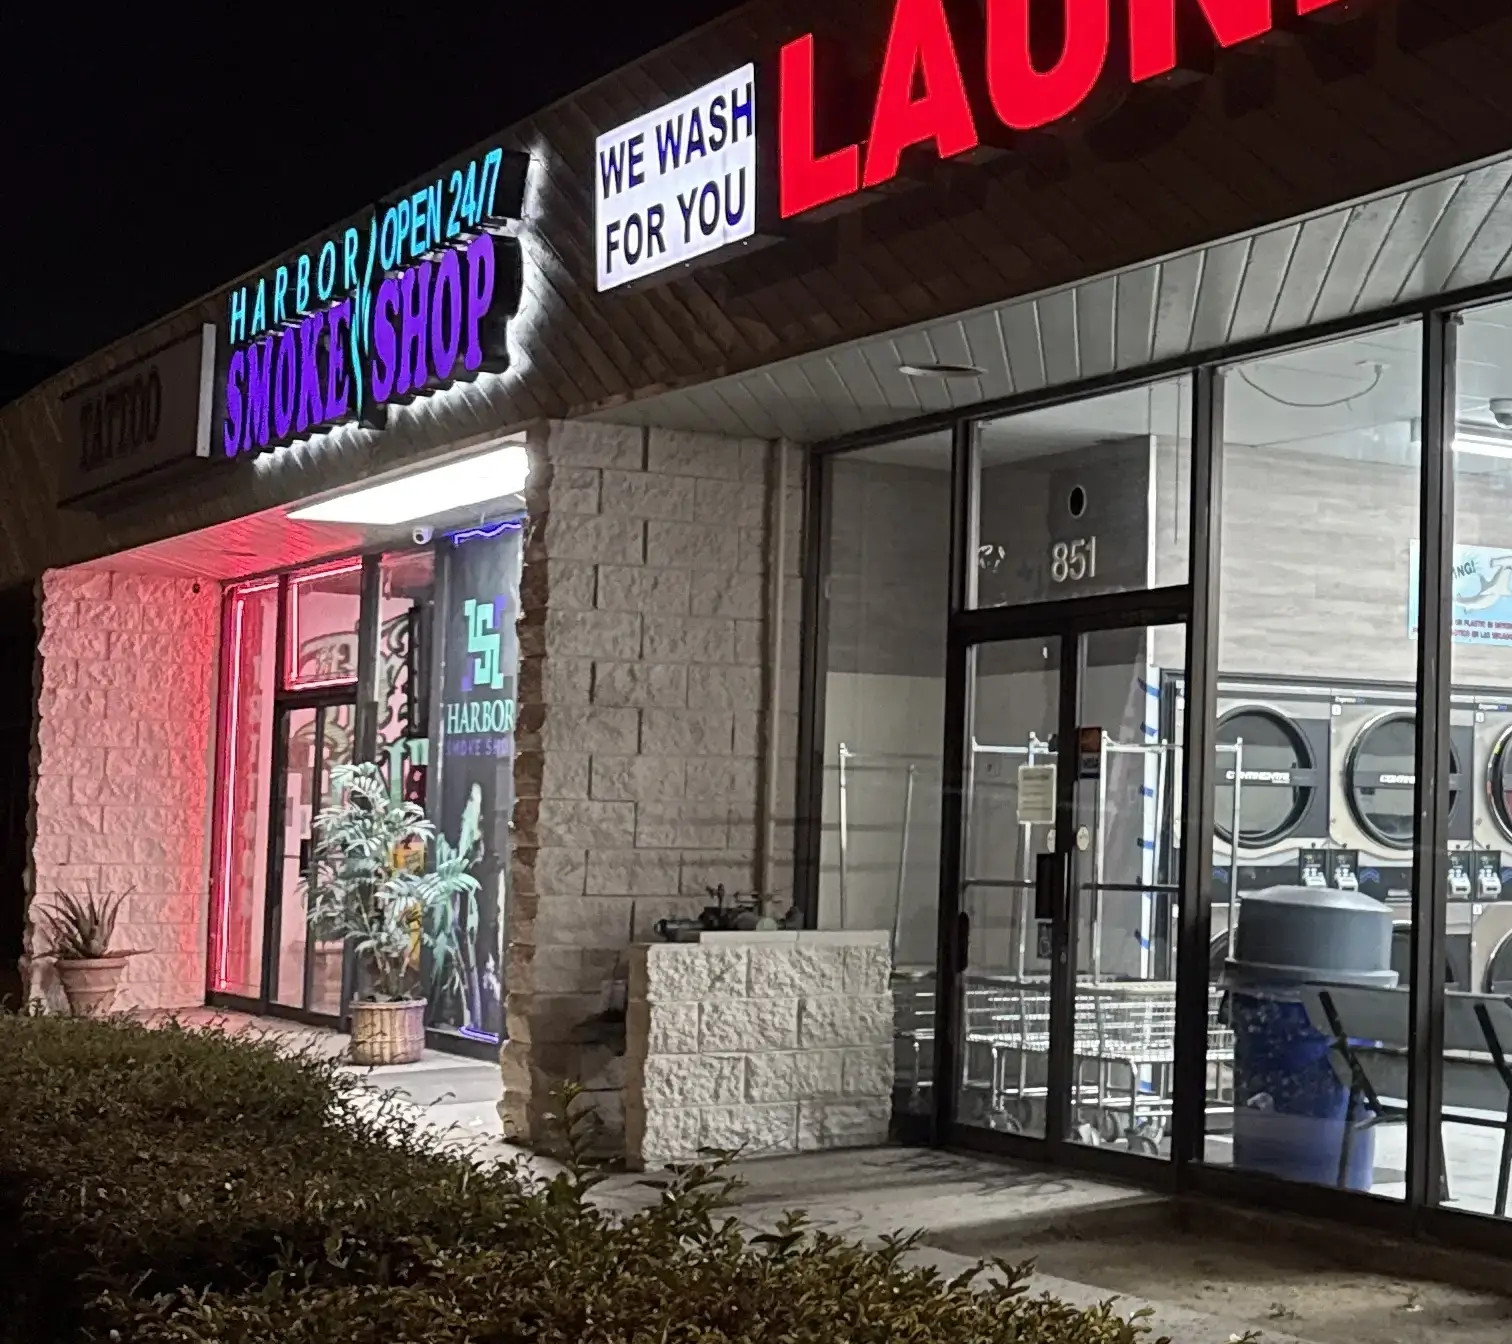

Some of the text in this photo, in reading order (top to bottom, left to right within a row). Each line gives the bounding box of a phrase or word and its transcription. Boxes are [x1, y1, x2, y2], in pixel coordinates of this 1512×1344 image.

[600, 81, 753, 199] WE WASH
[380, 147, 503, 272] OPEN 24/7
[606, 167, 746, 274] FOR YOU
[223, 231, 496, 458] SMOKE SHOP
[229, 227, 360, 345] HARBOR
[1052, 535, 1097, 582] 851
[447, 699, 515, 734] HARBOR
